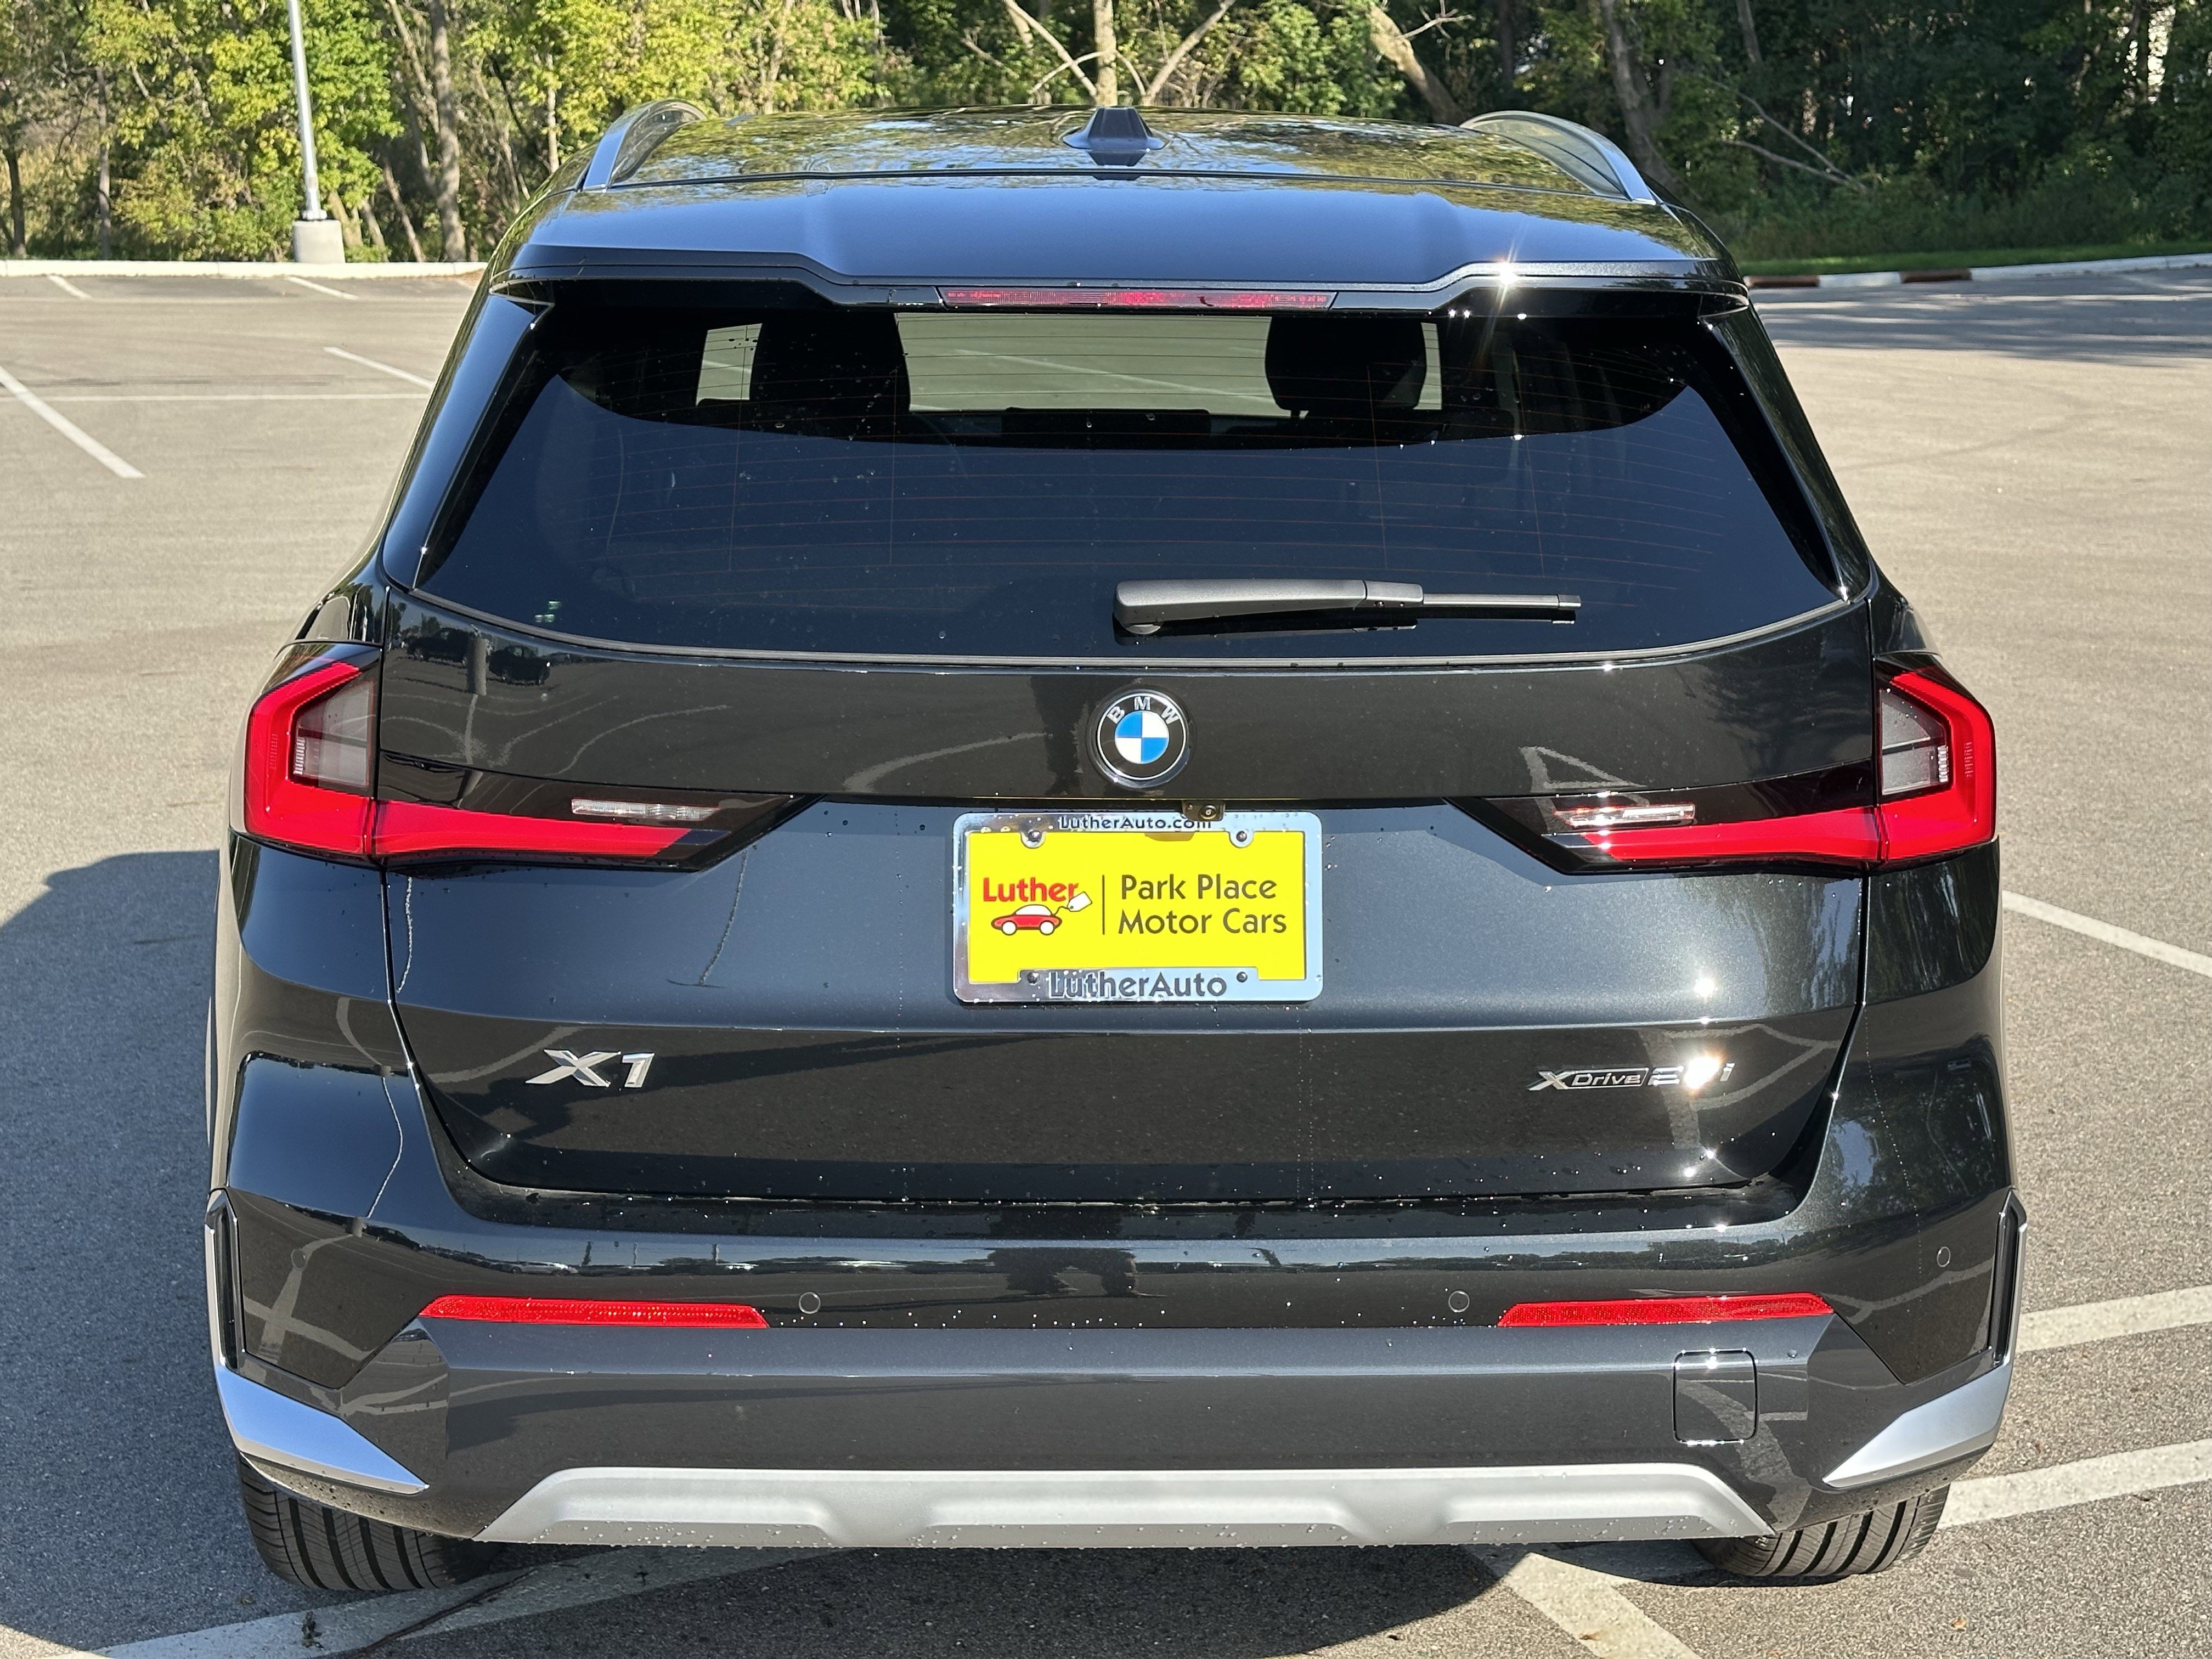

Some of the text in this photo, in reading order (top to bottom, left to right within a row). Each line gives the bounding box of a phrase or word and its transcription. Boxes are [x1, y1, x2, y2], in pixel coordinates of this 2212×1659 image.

[1107, 696, 1180, 725] BMW
[1058, 816, 1211, 830] LutherAuto.com
[983, 876, 1079, 902] Luther
[1121, 873, 1278, 900] Park Place
[1118, 907, 1287, 934] Motor Cars
[1049, 971, 1227, 998] LutherAuto
[524, 1048, 655, 1088] X1
[1647, 1062, 1735, 1087] 2i
